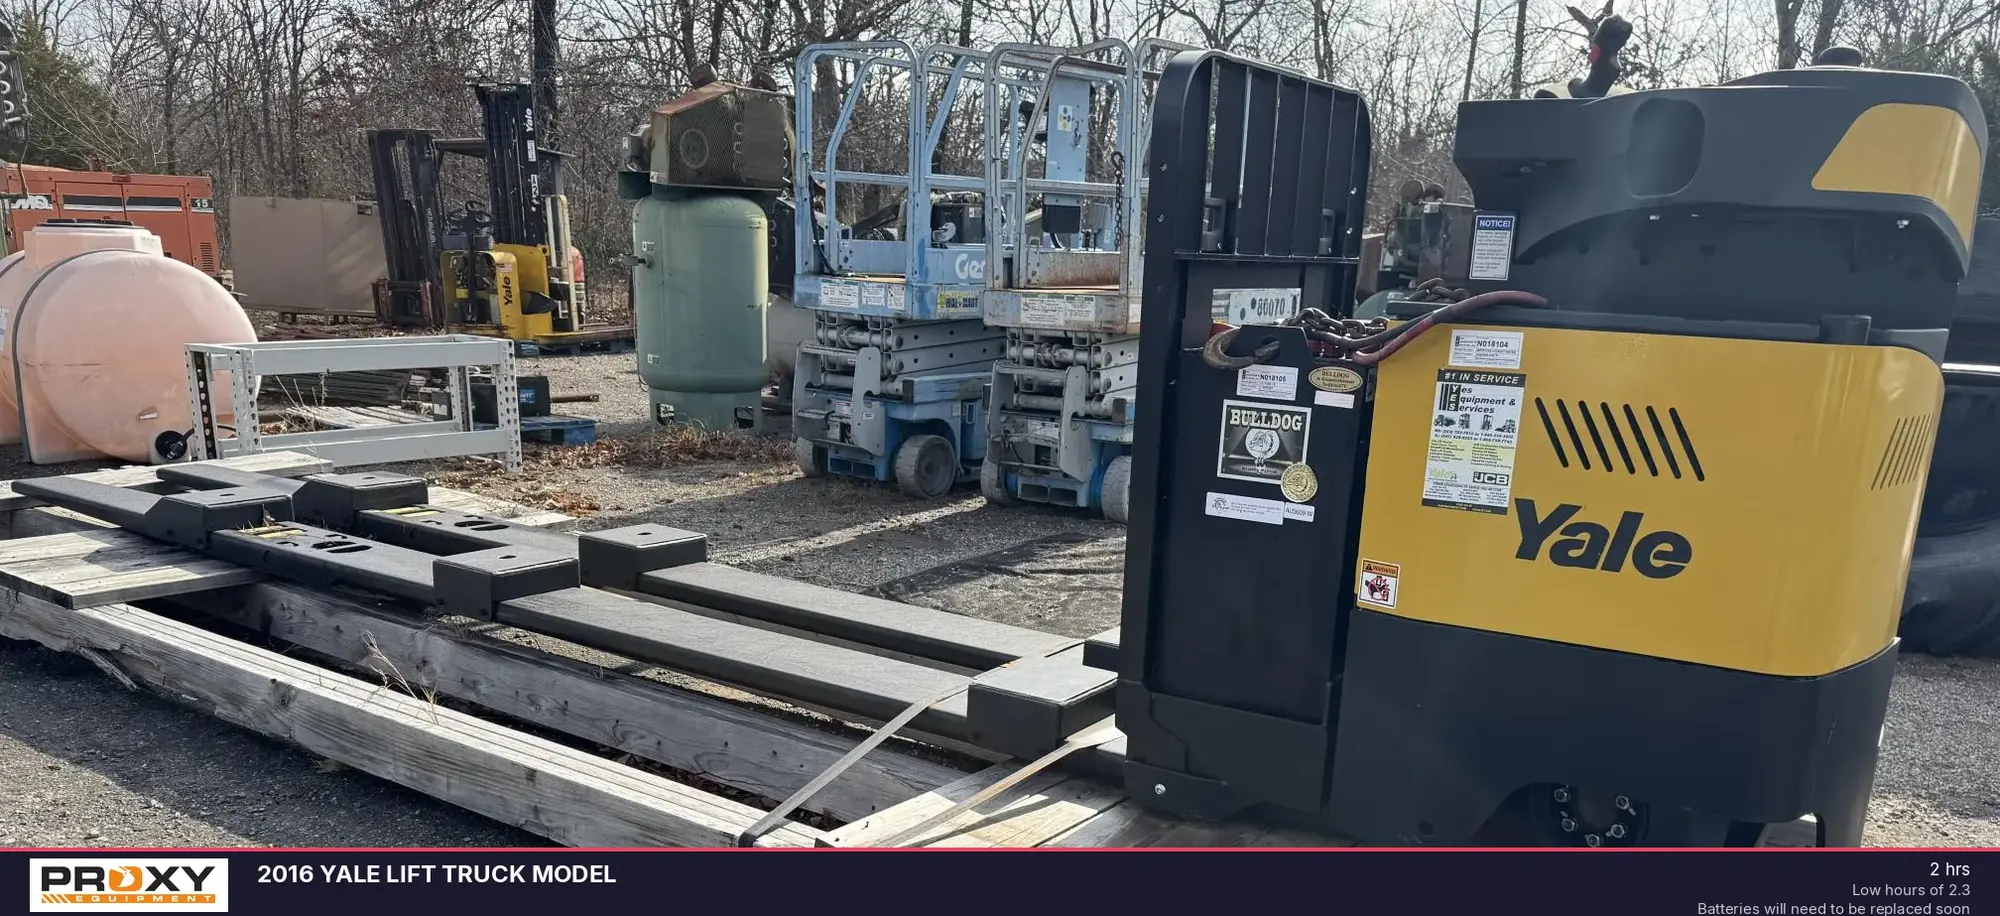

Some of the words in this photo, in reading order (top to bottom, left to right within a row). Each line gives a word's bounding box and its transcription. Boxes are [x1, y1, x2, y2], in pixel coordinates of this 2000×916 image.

[525, 107, 533, 132] Yale
[195, 199, 209, 208] 15
[1479, 219, 1511, 227] NOTICE!
[503, 276, 513, 306] Yale
[1476, 340, 1509, 348] N018104
[1473, 374, 1519, 384] SERVICE
[1229, 409, 1303, 431] BULLDOG
[1473, 472, 1508, 485] JCB
[1514, 497, 1693, 580] Yale
